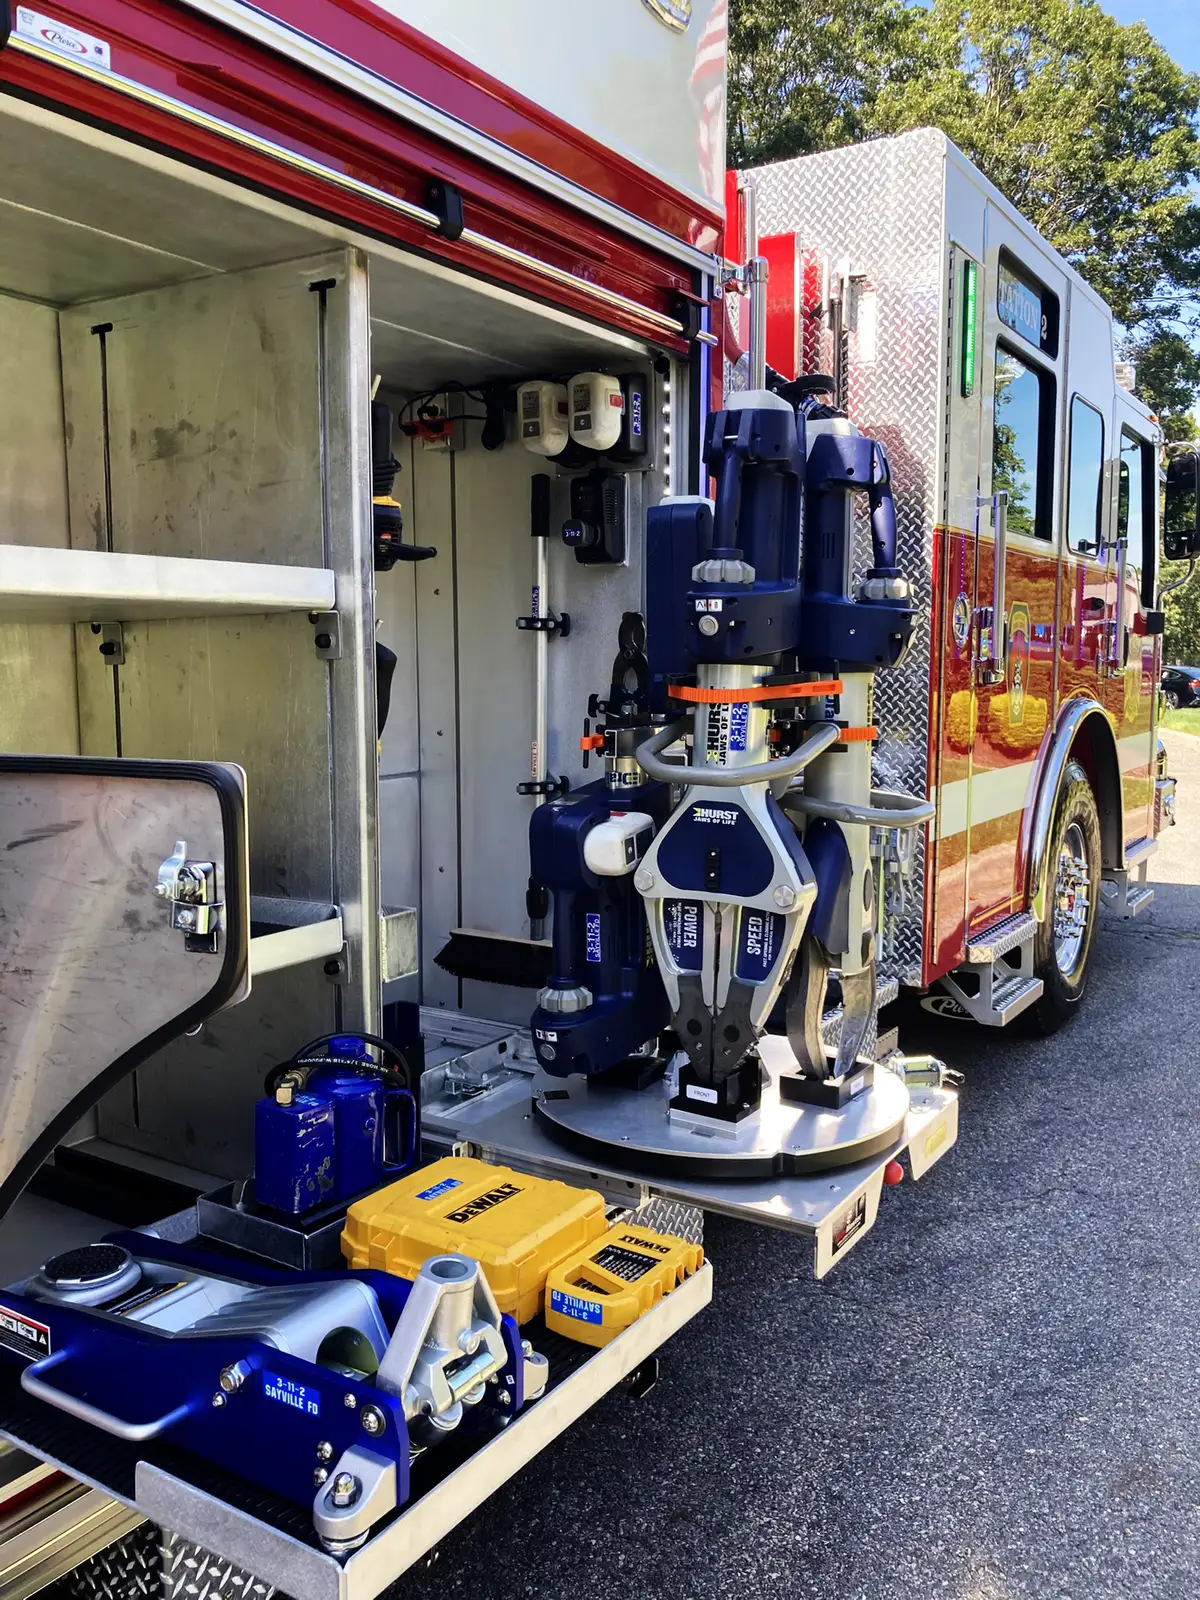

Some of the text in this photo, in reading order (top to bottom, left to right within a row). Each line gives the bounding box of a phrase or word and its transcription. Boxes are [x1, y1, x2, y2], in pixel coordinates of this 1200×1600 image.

[999, 282, 1047, 340] TATION 2
[707, 686, 720, 750] HURS
[720, 716, 728, 730] OF
[741, 703, 747, 713] FD
[730, 707, 742, 742] 3-11-2
[719, 733, 728, 765] JAWS
[700, 808, 738, 820] HURST
[587, 922, 595, 953] 3-11-2
[683, 906, 697, 948] POWER
[746, 916, 762, 955] SPEED
[693, 1090, 710, 1098] FRONT
[552, 1291, 601, 1314] SAYVILLE FD
[562, 1304, 588, 1320] 3-11-2
[265, 1384, 318, 1415] SAYVILLE FD
[276, 1378, 305, 1397] 3-11-2
